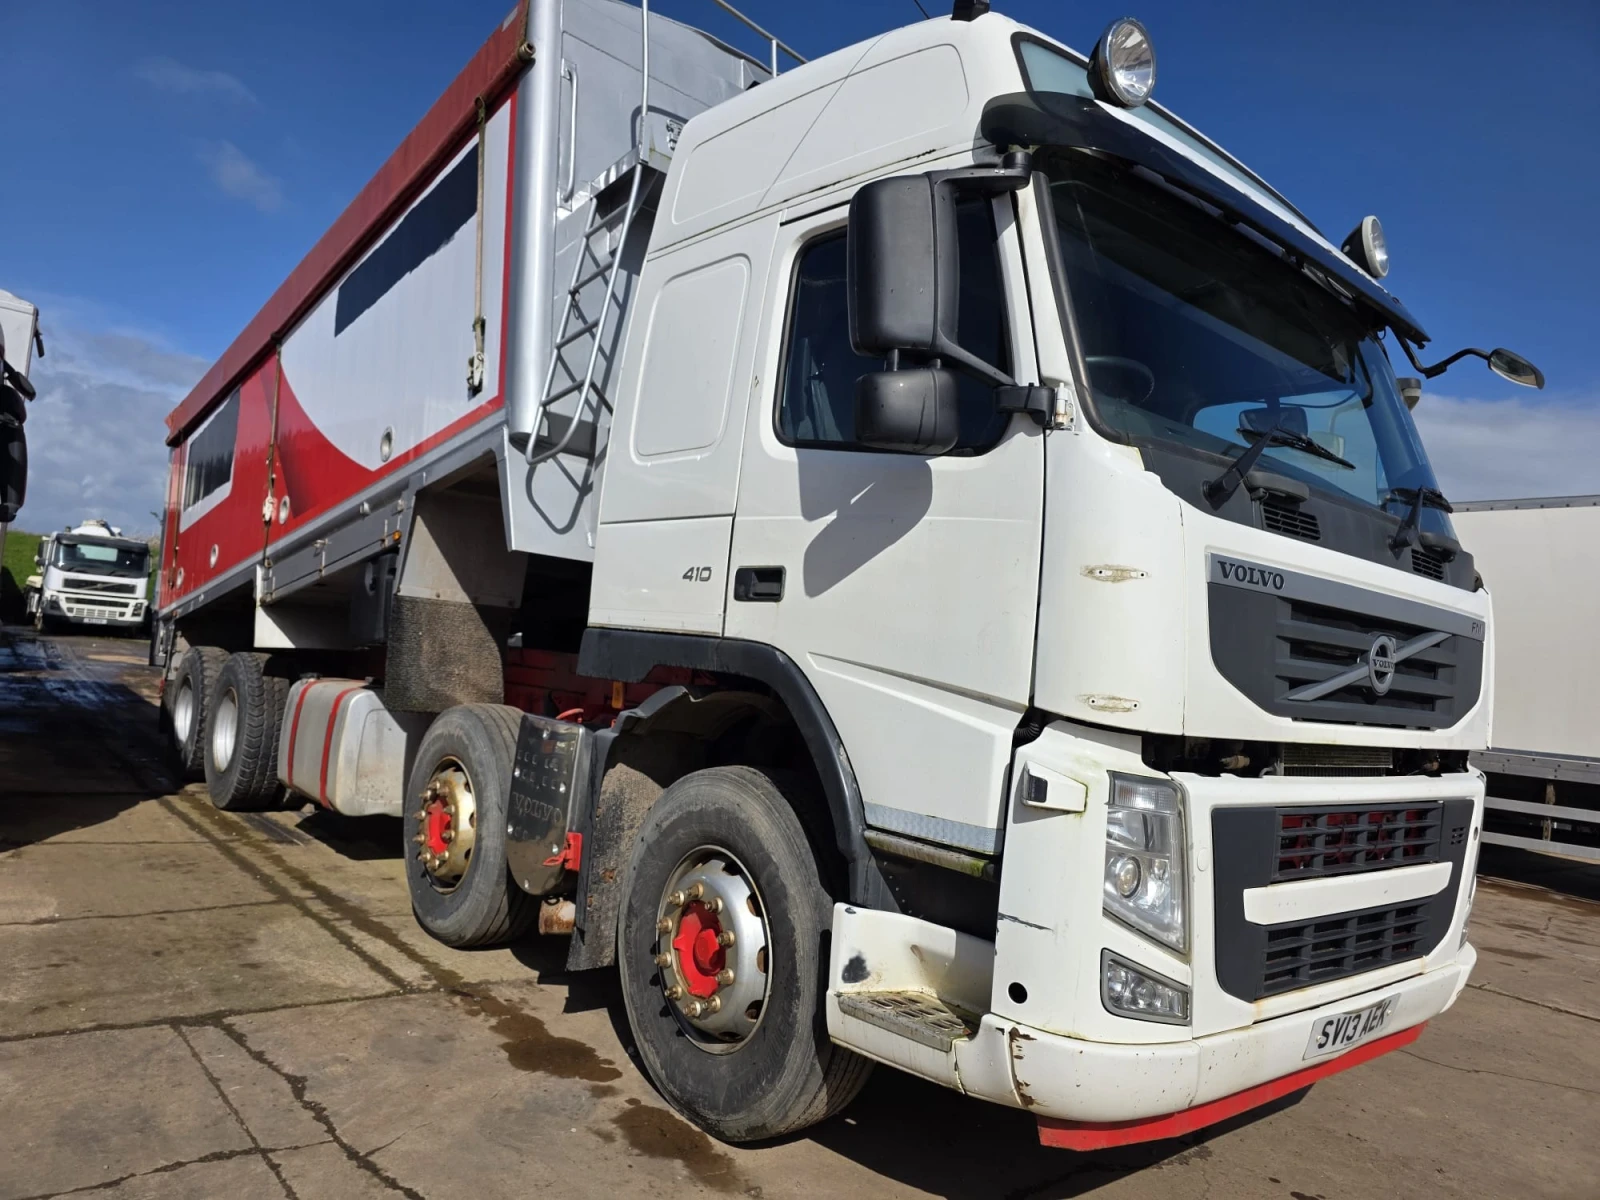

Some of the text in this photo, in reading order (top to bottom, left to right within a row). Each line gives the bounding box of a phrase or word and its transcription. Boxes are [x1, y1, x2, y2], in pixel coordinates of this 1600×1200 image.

[682, 566, 712, 582] 410
[1217, 560, 1285, 590] VOLVO
[512, 791, 563, 825] VOLVO
[1317, 999, 1392, 1050] SV13 AEK
